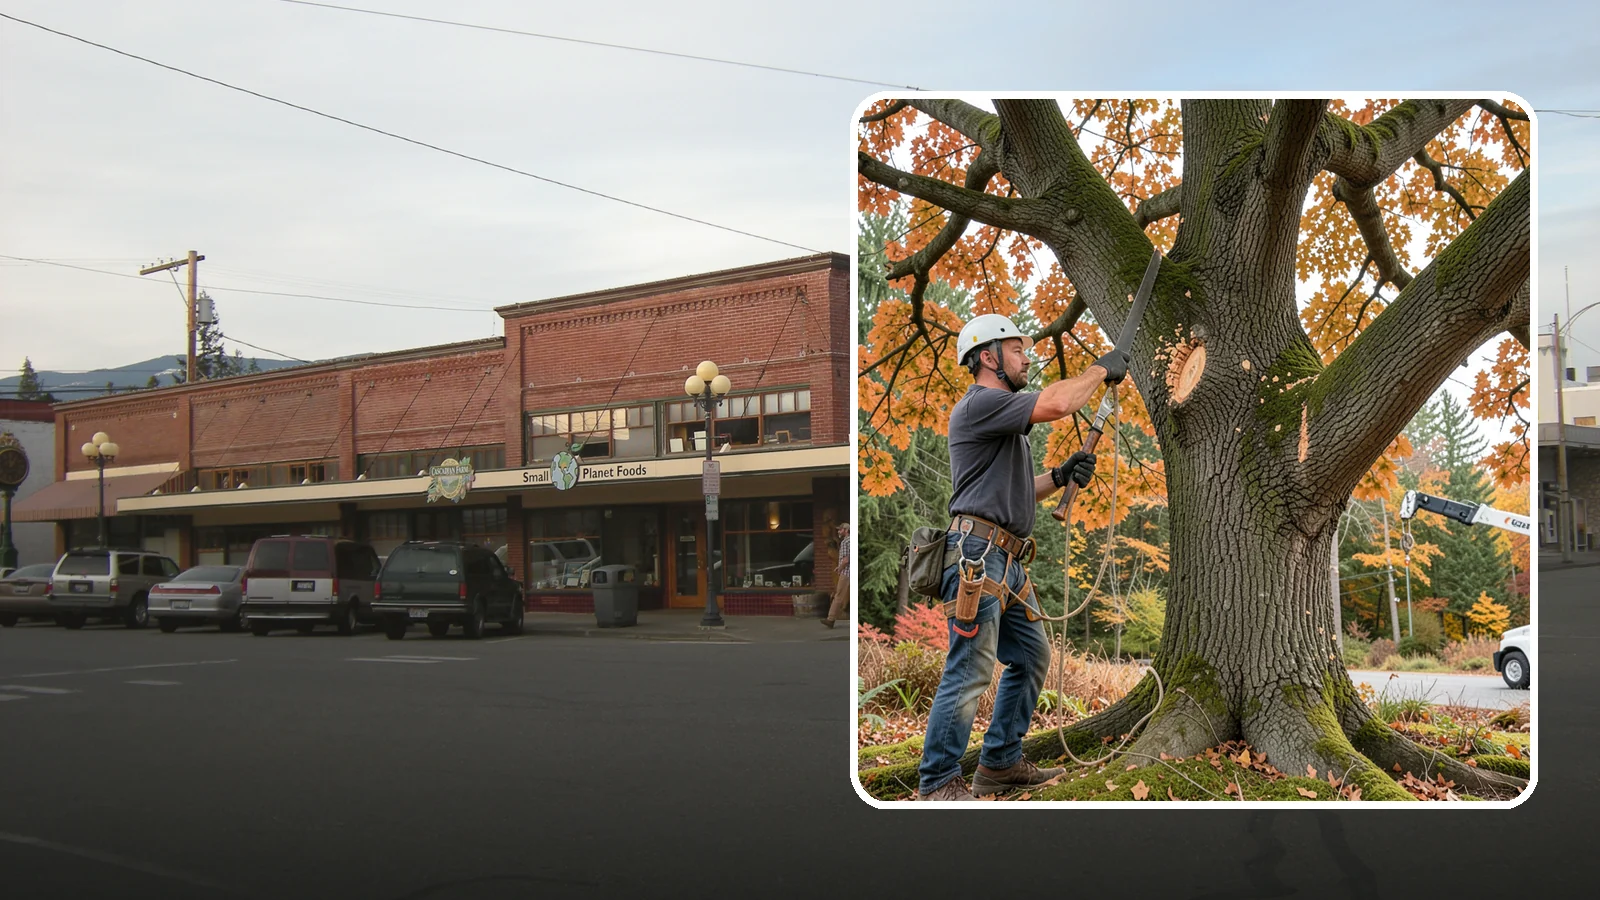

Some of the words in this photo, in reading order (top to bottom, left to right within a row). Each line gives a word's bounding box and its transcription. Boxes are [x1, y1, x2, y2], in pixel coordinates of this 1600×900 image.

[523, 471, 549, 483] Small
[582, 467, 614, 479] Planet
[617, 464, 647, 477] Foods
